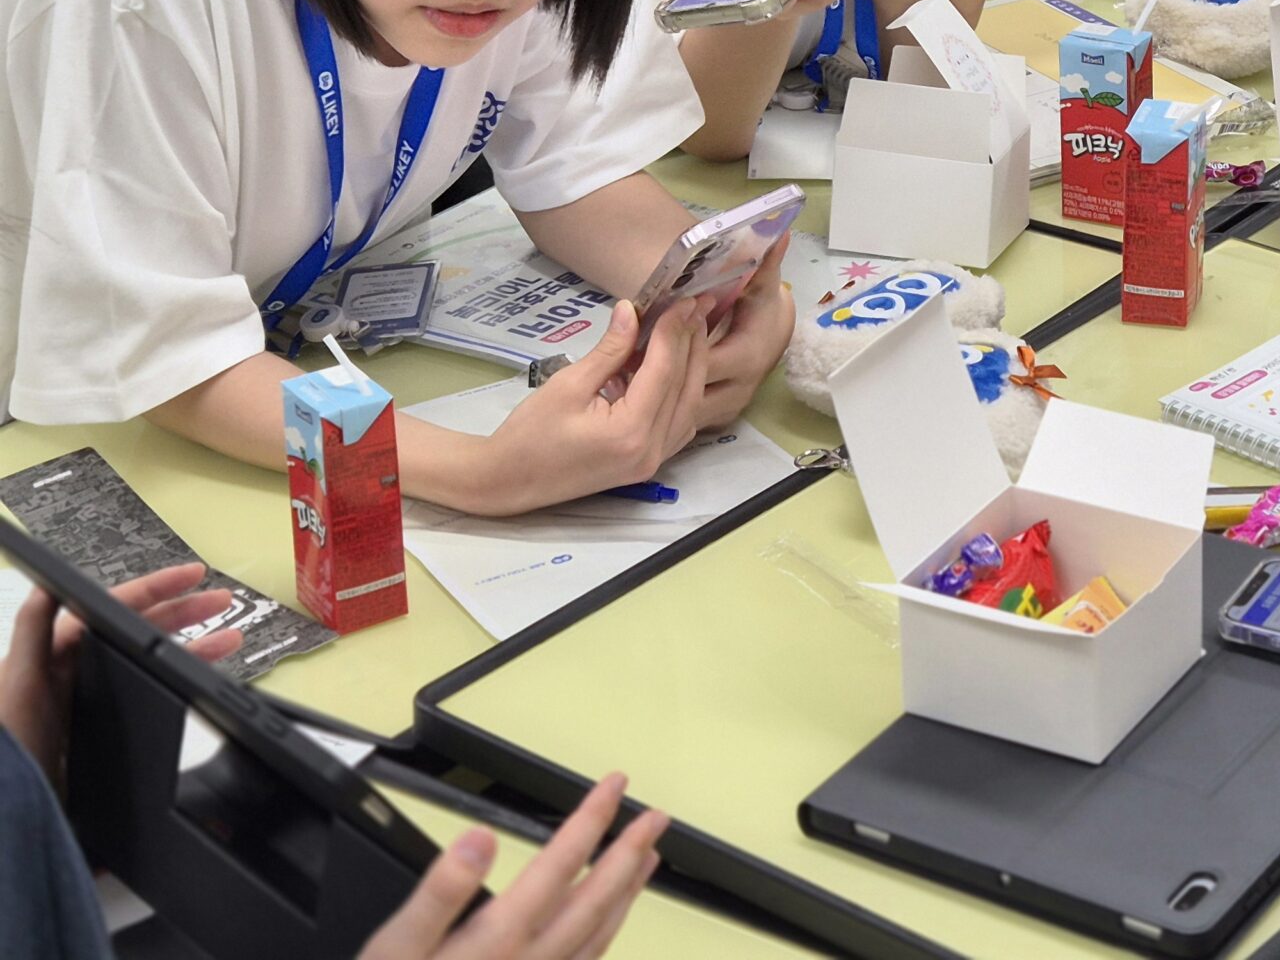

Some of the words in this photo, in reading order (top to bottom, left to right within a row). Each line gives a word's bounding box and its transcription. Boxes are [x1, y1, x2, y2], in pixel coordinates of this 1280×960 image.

[320, 88, 341, 138] LIKEY
[391, 140, 415, 192] LIKEY
[1063, 132, 1124, 160] 피크닉
[445, 276, 542, 319] 가이드북
[473, 272, 584, 327] 음보호훈련
[508, 290, 613, 338] 라이키
[291, 499, 326, 546] 피크닉
